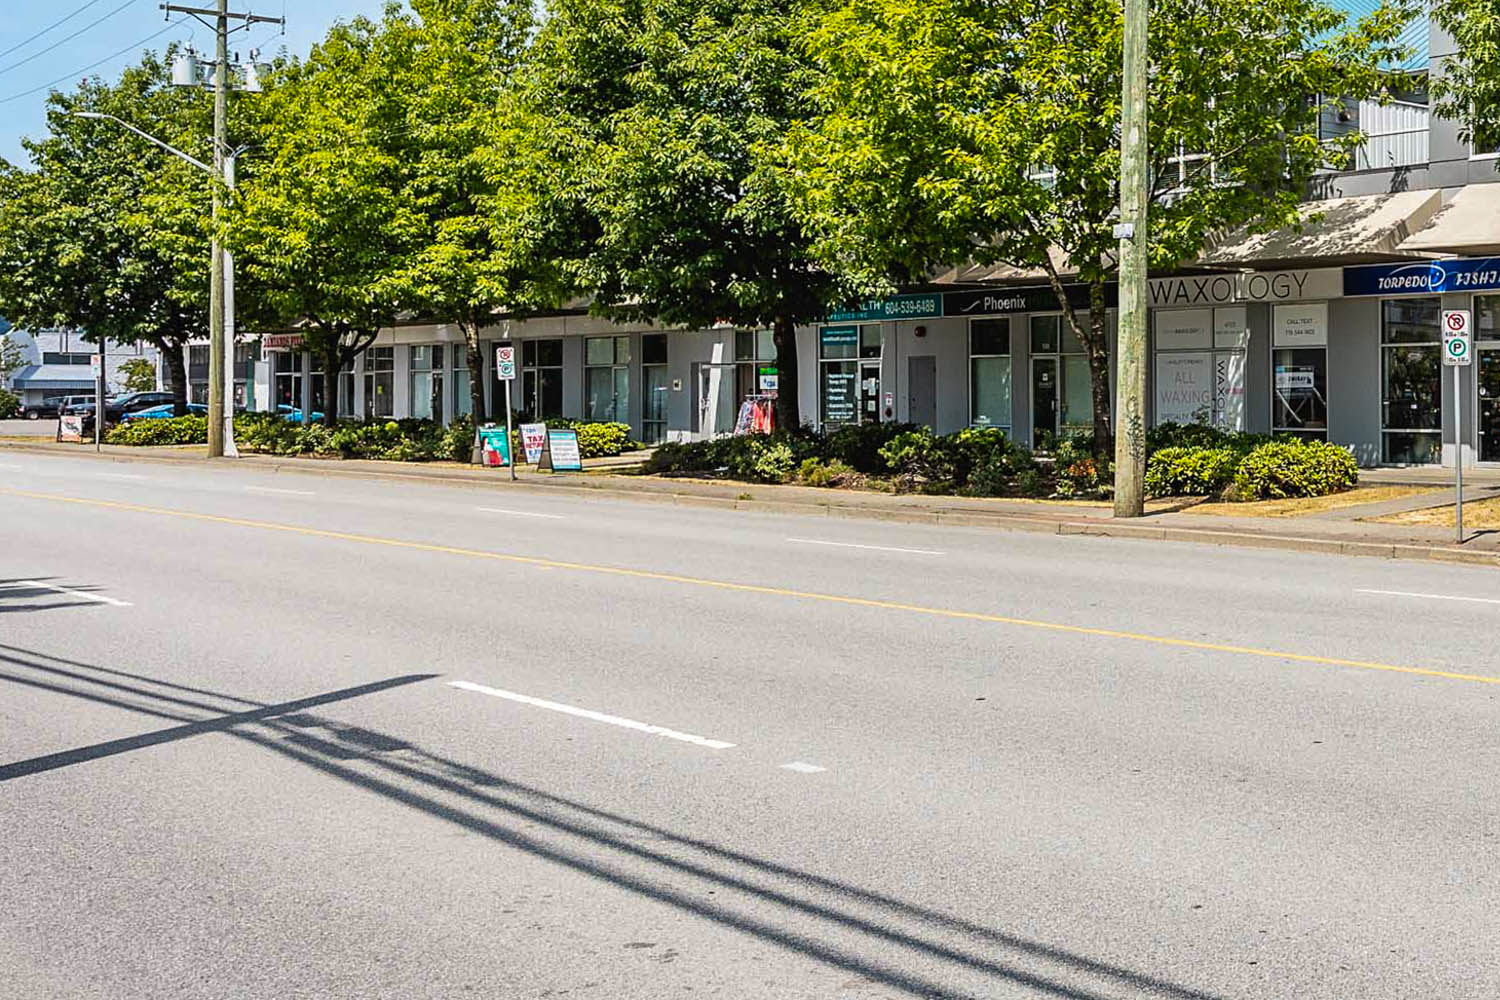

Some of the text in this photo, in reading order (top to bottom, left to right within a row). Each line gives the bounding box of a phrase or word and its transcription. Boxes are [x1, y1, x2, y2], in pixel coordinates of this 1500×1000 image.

[1150, 271, 1309, 305] WAXOLOGY
[984, 294, 1026, 311] Phoenix
[1160, 390, 1210, 404] WAXING
[526, 435, 544, 443] TAX
